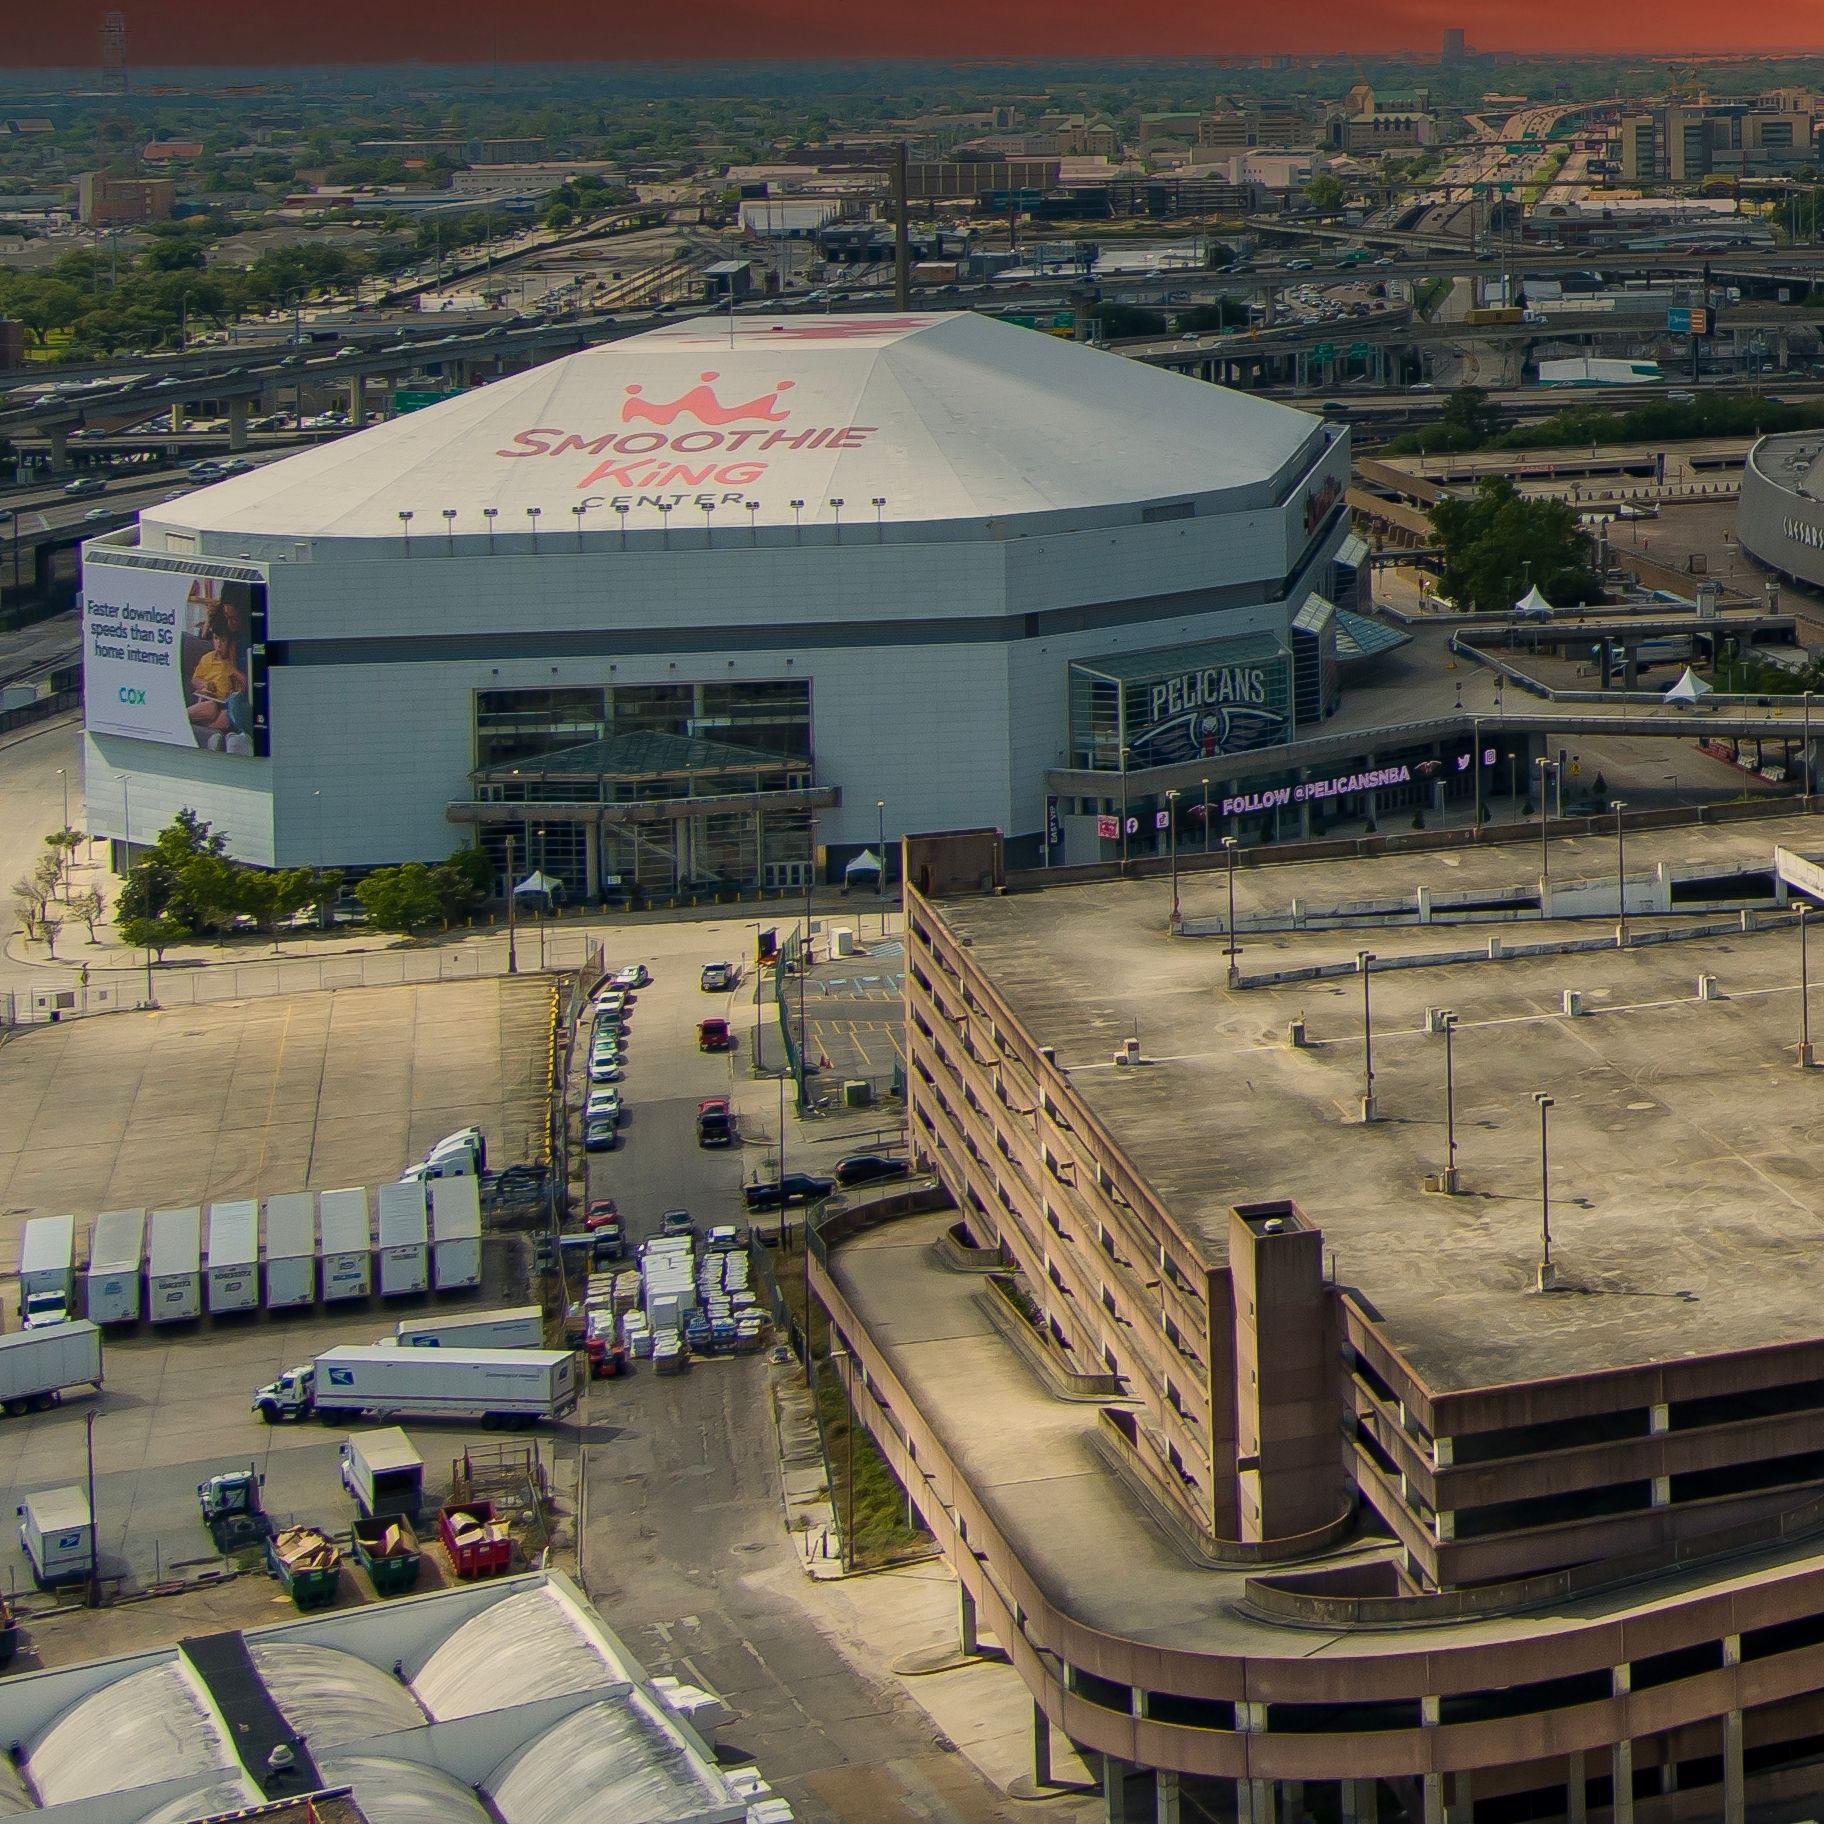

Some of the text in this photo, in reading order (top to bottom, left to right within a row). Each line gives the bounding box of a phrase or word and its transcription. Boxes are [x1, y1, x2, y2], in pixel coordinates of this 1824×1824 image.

[496, 426, 880, 458] SMOOTHIE
[580, 492, 744, 509] CENTER
[1782, 515, 1824, 549] CAESARS
[87, 599, 176, 626] Faster download
[90, 621, 174, 645] speeds than 5G
[94, 639, 171, 667] home internet
[1152, 668, 1265, 721] PELICANS
[1221, 764, 1411, 816] FOLLOW @PELICANSNBA
